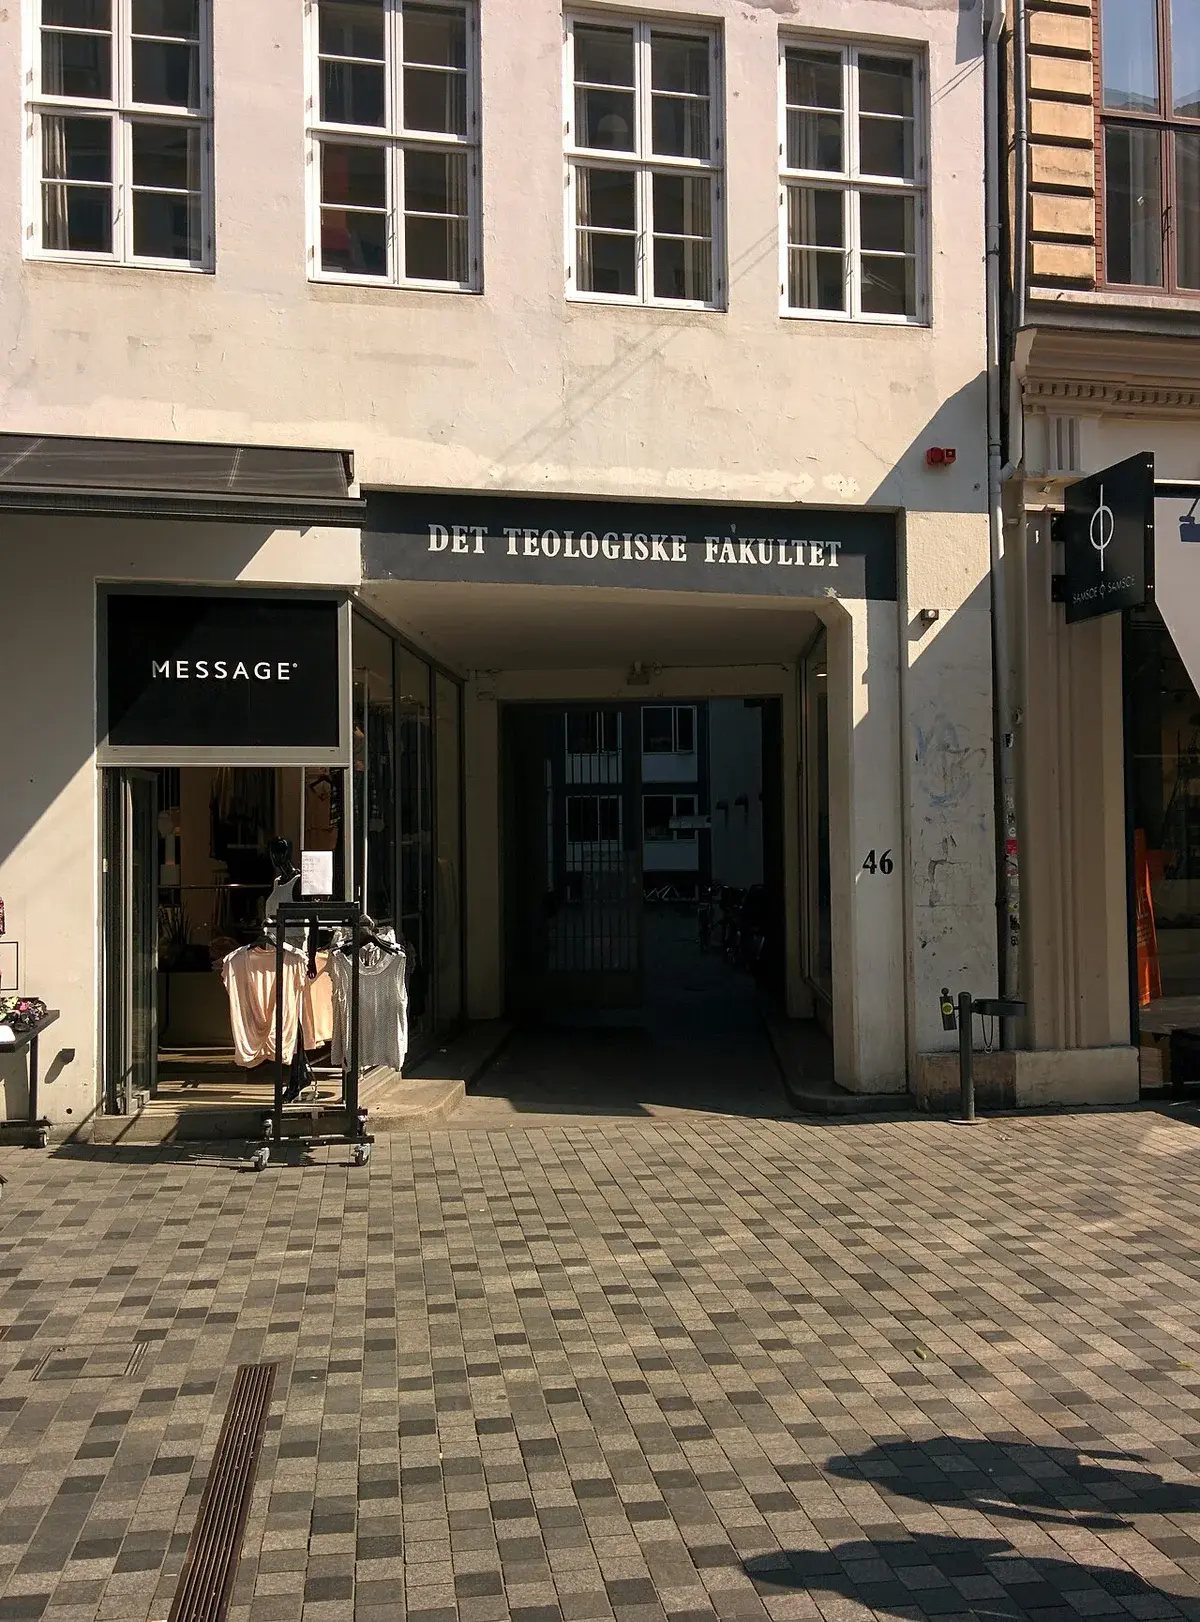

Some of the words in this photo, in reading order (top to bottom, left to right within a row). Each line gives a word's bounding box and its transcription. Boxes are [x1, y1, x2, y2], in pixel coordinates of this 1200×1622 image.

[427, 523, 488, 555] DET
[502, 526, 688, 563] TEOLOGISKE
[704, 534, 842, 568] FAKULTET
[862, 848, 894, 875] 46
